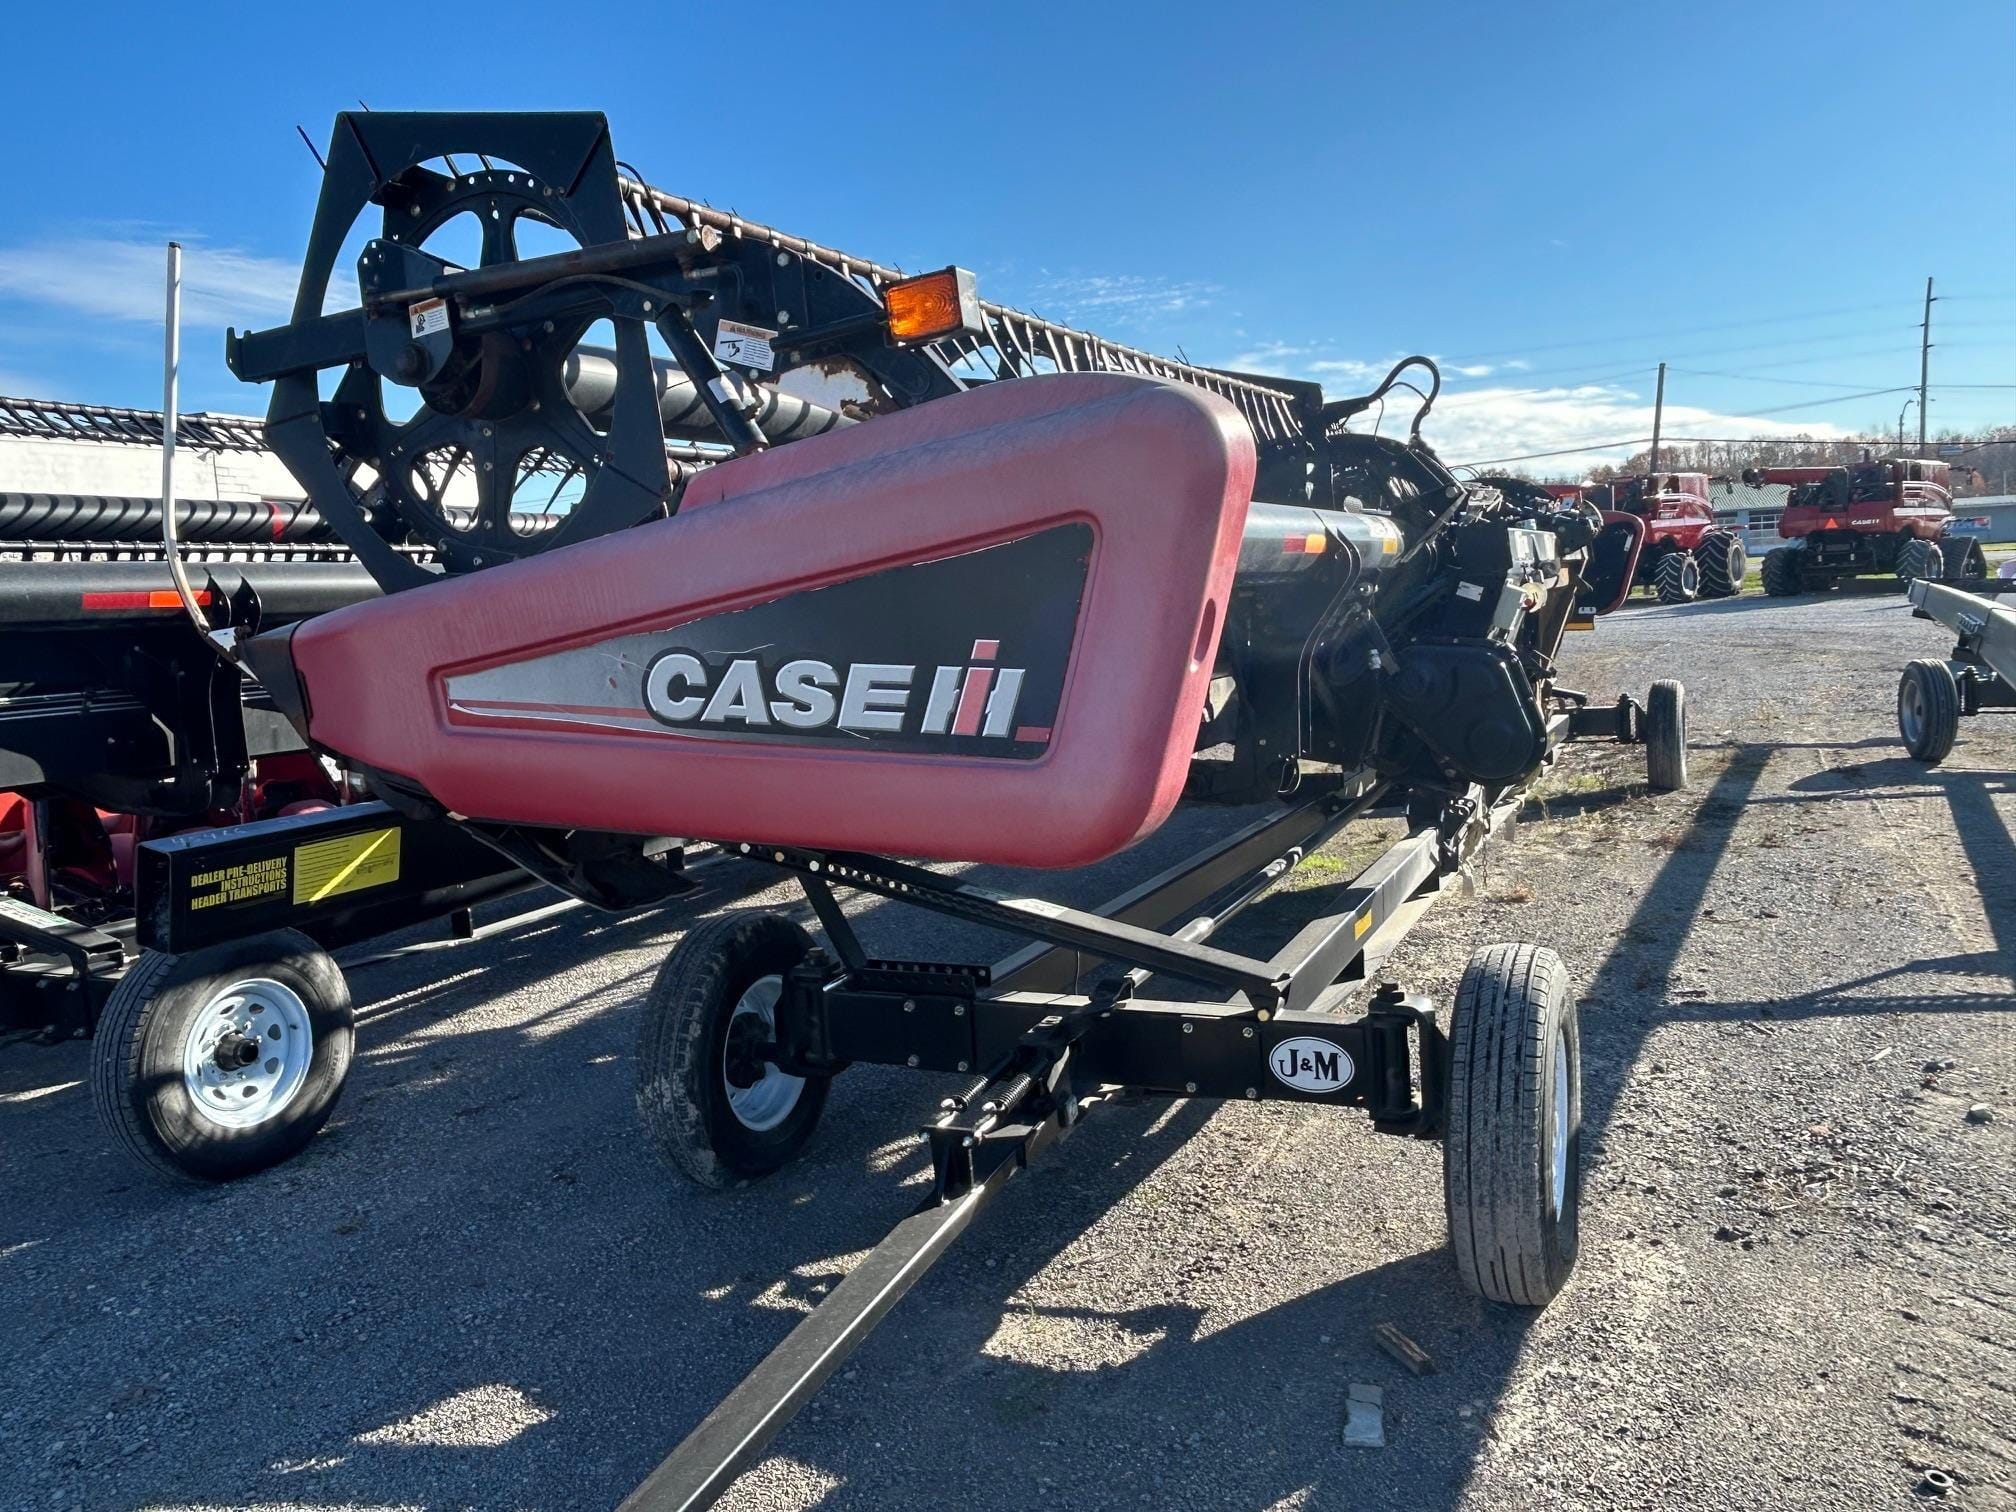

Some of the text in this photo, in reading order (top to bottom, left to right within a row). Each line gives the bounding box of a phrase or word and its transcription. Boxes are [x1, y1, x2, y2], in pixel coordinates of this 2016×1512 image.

[645, 652, 916, 731] CASE
[191, 856, 288, 888] DEALER PRE-DELIVERY
[220, 867, 288, 892] INSTRUCTIONS
[191, 878, 288, 911] HEADER TRANSPORTS
[1278, 1049, 1340, 1081] J&M
